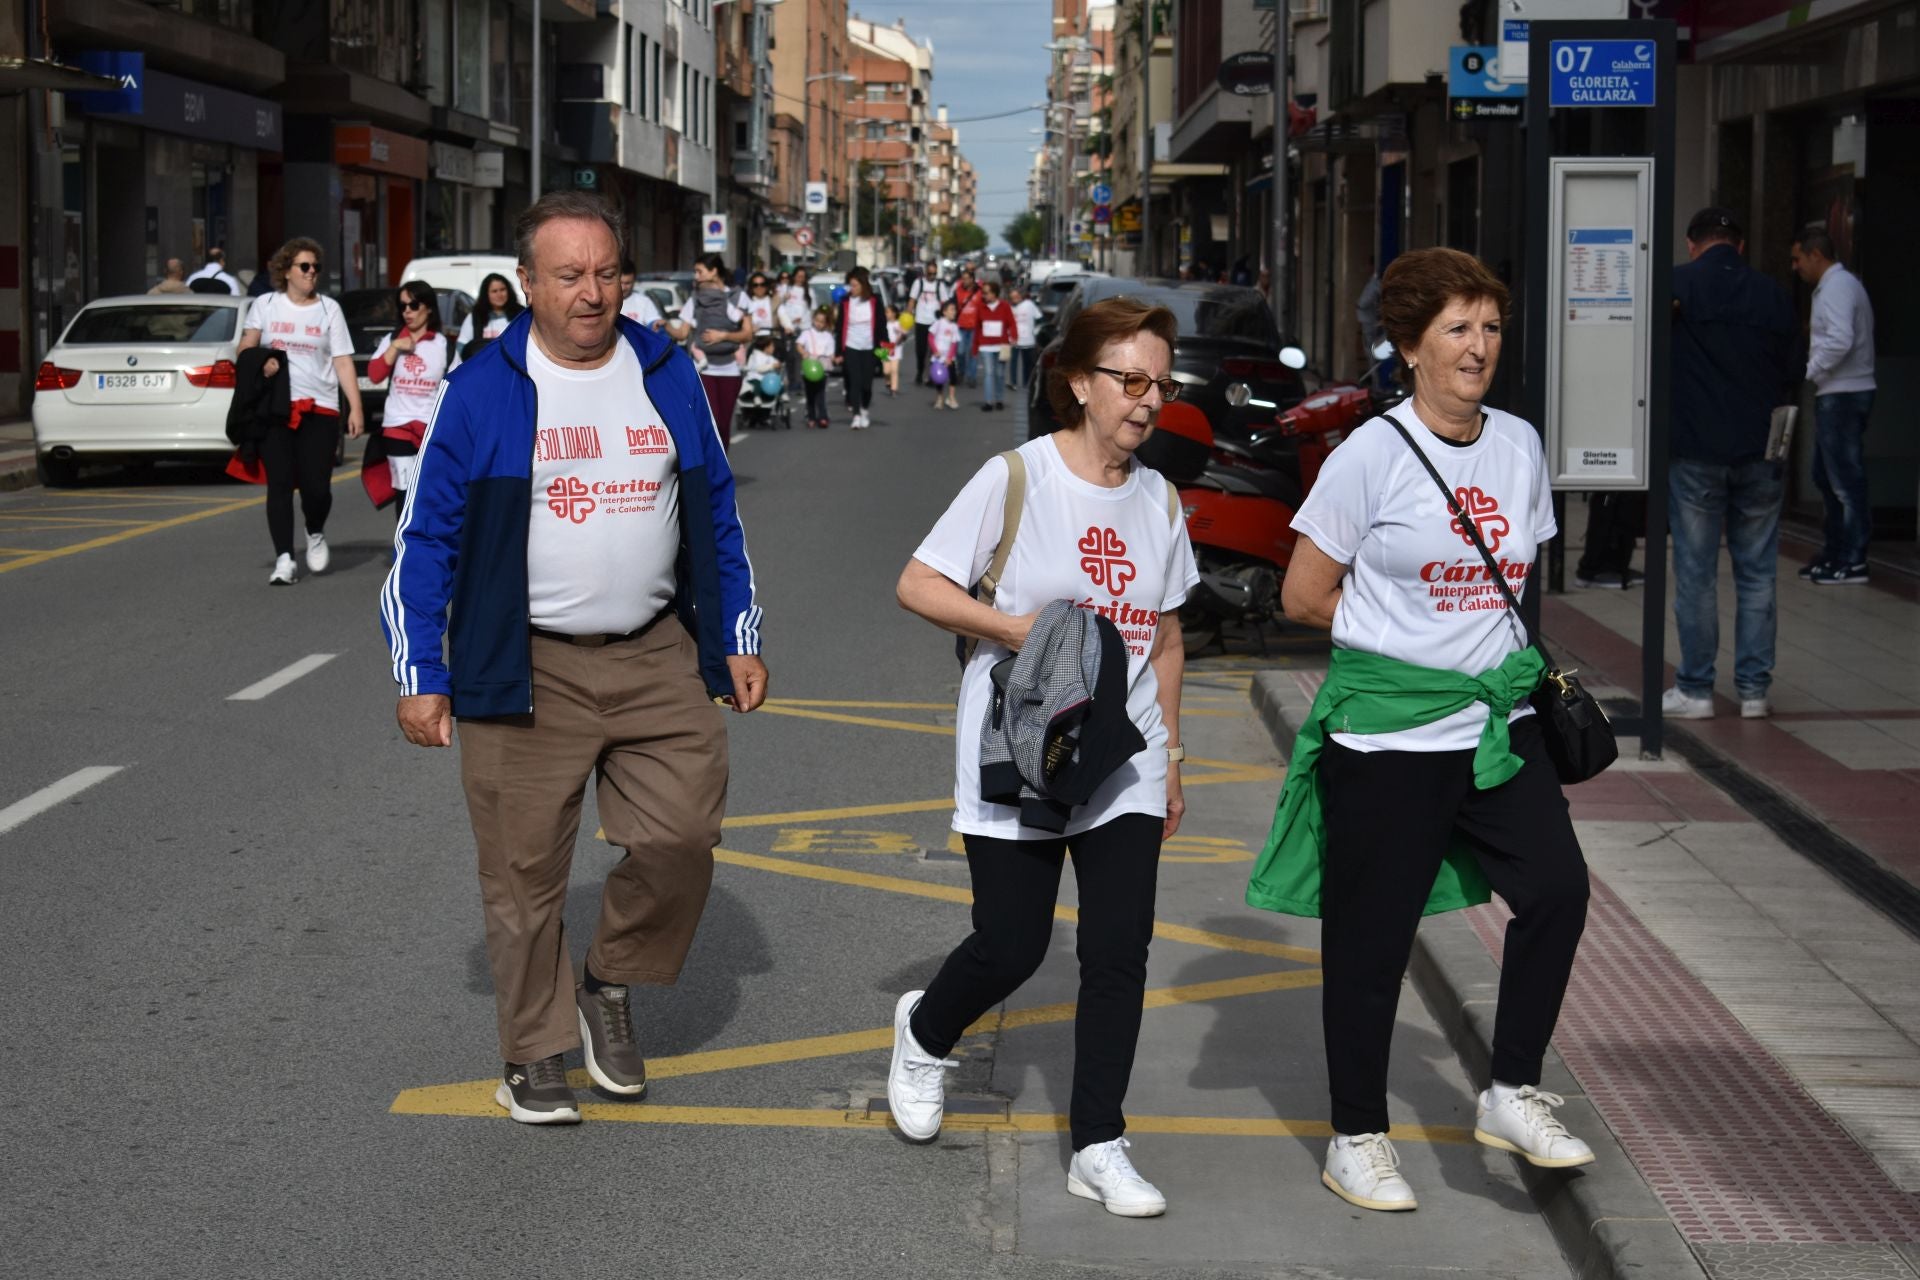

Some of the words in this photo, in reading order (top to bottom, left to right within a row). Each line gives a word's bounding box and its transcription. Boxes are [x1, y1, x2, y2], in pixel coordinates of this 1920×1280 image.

[1556, 46, 1593, 73] 07
[1611, 60, 1651, 69] Calahorra
[1569, 76, 1629, 88] GLORIETA
[1572, 89, 1636, 101] GALLARZA
[1476, 104, 1518, 116] ServiRed
[107, 375, 137, 388] 6328
[142, 374, 165, 388] GJY
[625, 425, 668, 447] berlin
[540, 425, 602, 461] SOLIDARIA
[592, 479, 661, 494] Cáritas
[619, 504, 655, 513] Calahorra
[1437, 600, 1453, 611] de
